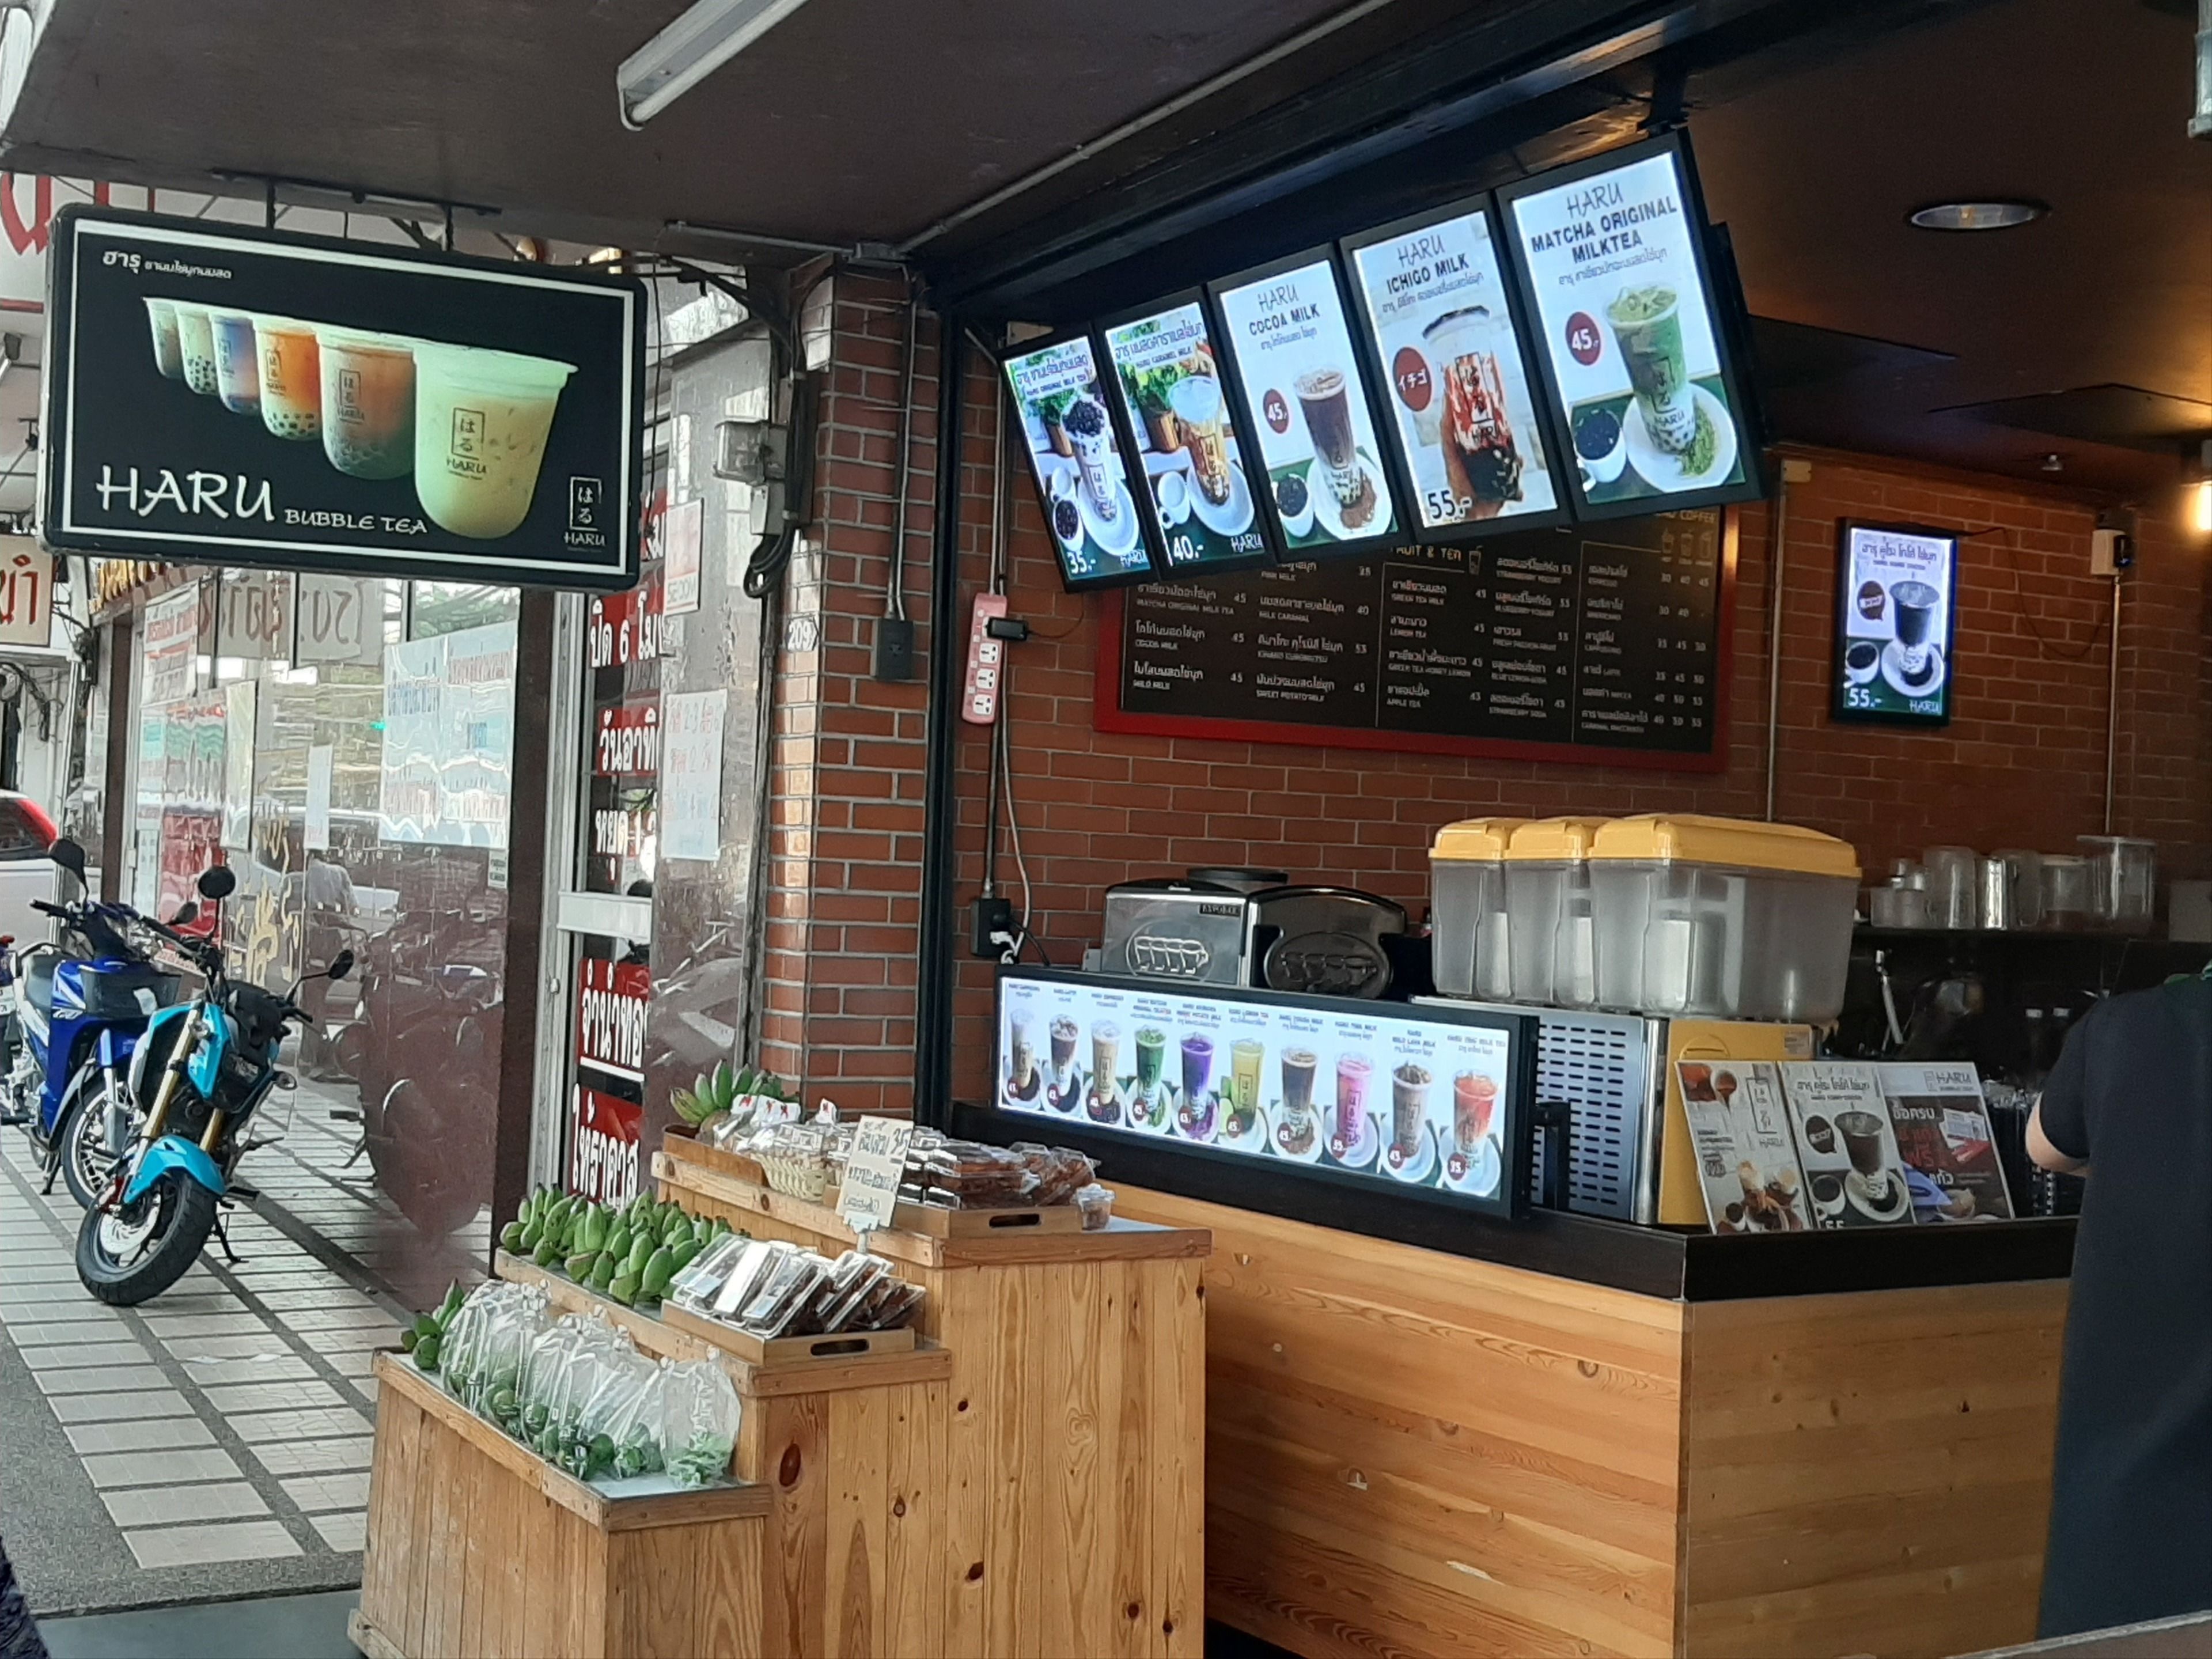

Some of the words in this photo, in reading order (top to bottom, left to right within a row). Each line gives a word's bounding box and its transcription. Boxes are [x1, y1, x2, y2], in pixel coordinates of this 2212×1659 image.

[1567, 183, 1624, 218] HARU
[1531, 219, 1594, 252] MATCHA
[1600, 196, 1677, 233] ORIGINAL
[1397, 234, 1446, 267] HARU
[1572, 230, 1642, 263] MILKTEA
[1387, 266, 1431, 294] ICHIGO
[1434, 252, 1469, 278] MILK
[1257, 283, 1300, 313] HARU
[1249, 311, 1288, 336] COCOA
[1290, 303, 1320, 324] MILK
[1398, 366, 1428, 391] イチゴ
[447, 456, 486, 474] HARU
[96, 465, 275, 522] HARU
[285, 507, 375, 532] BUBBLE
[381, 514, 427, 535] TEA
[1427, 488, 1472, 520] 55.-
[564, 532, 606, 546] HARU
[1173, 535, 1204, 560] 40.-
[1231, 533, 1263, 552] HARU
[1067, 550, 1096, 574] 35.-
[590, 599, 612, 667] ปิด
[620, 621, 630, 662] 6
[788, 620, 813, 651] 209
[1848, 688, 1882, 707] 55.-
[583, 958, 646, 1069] จำนำทอ
